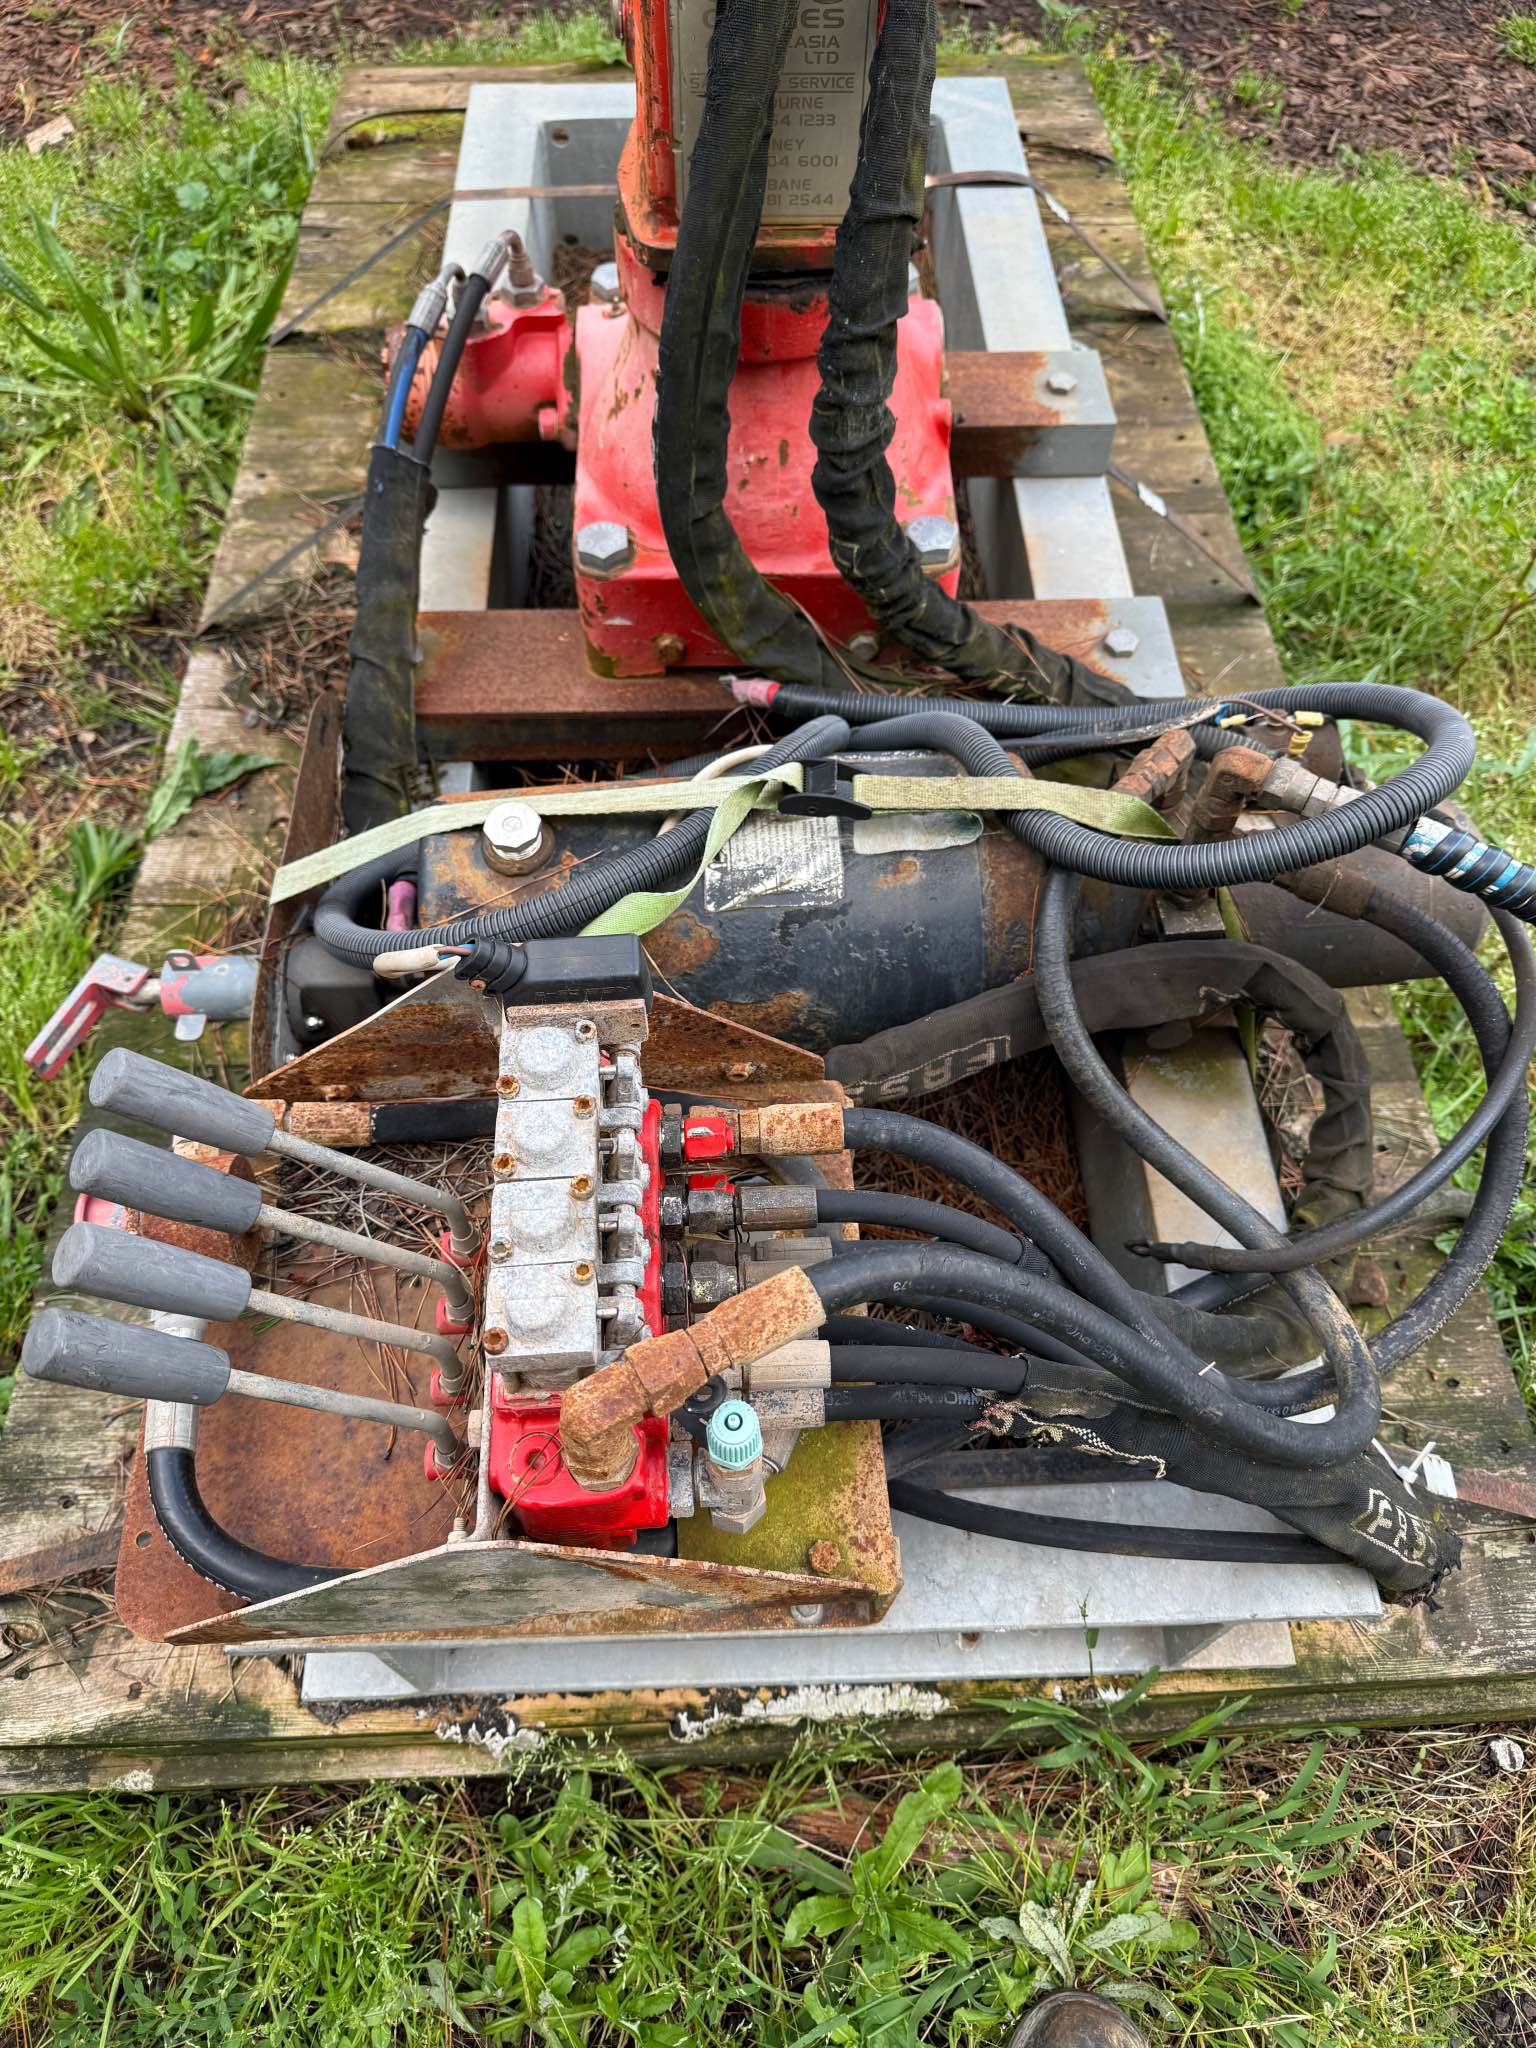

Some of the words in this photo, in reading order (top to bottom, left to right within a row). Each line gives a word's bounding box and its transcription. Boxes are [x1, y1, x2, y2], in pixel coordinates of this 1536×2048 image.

[789, 35, 840, 48] ASIA
[804, 51, 839, 64] LTD
[788, 77, 854, 89] SERVICE
[799, 114, 836, 127] 1233
[788, 193, 833, 206] 2544
